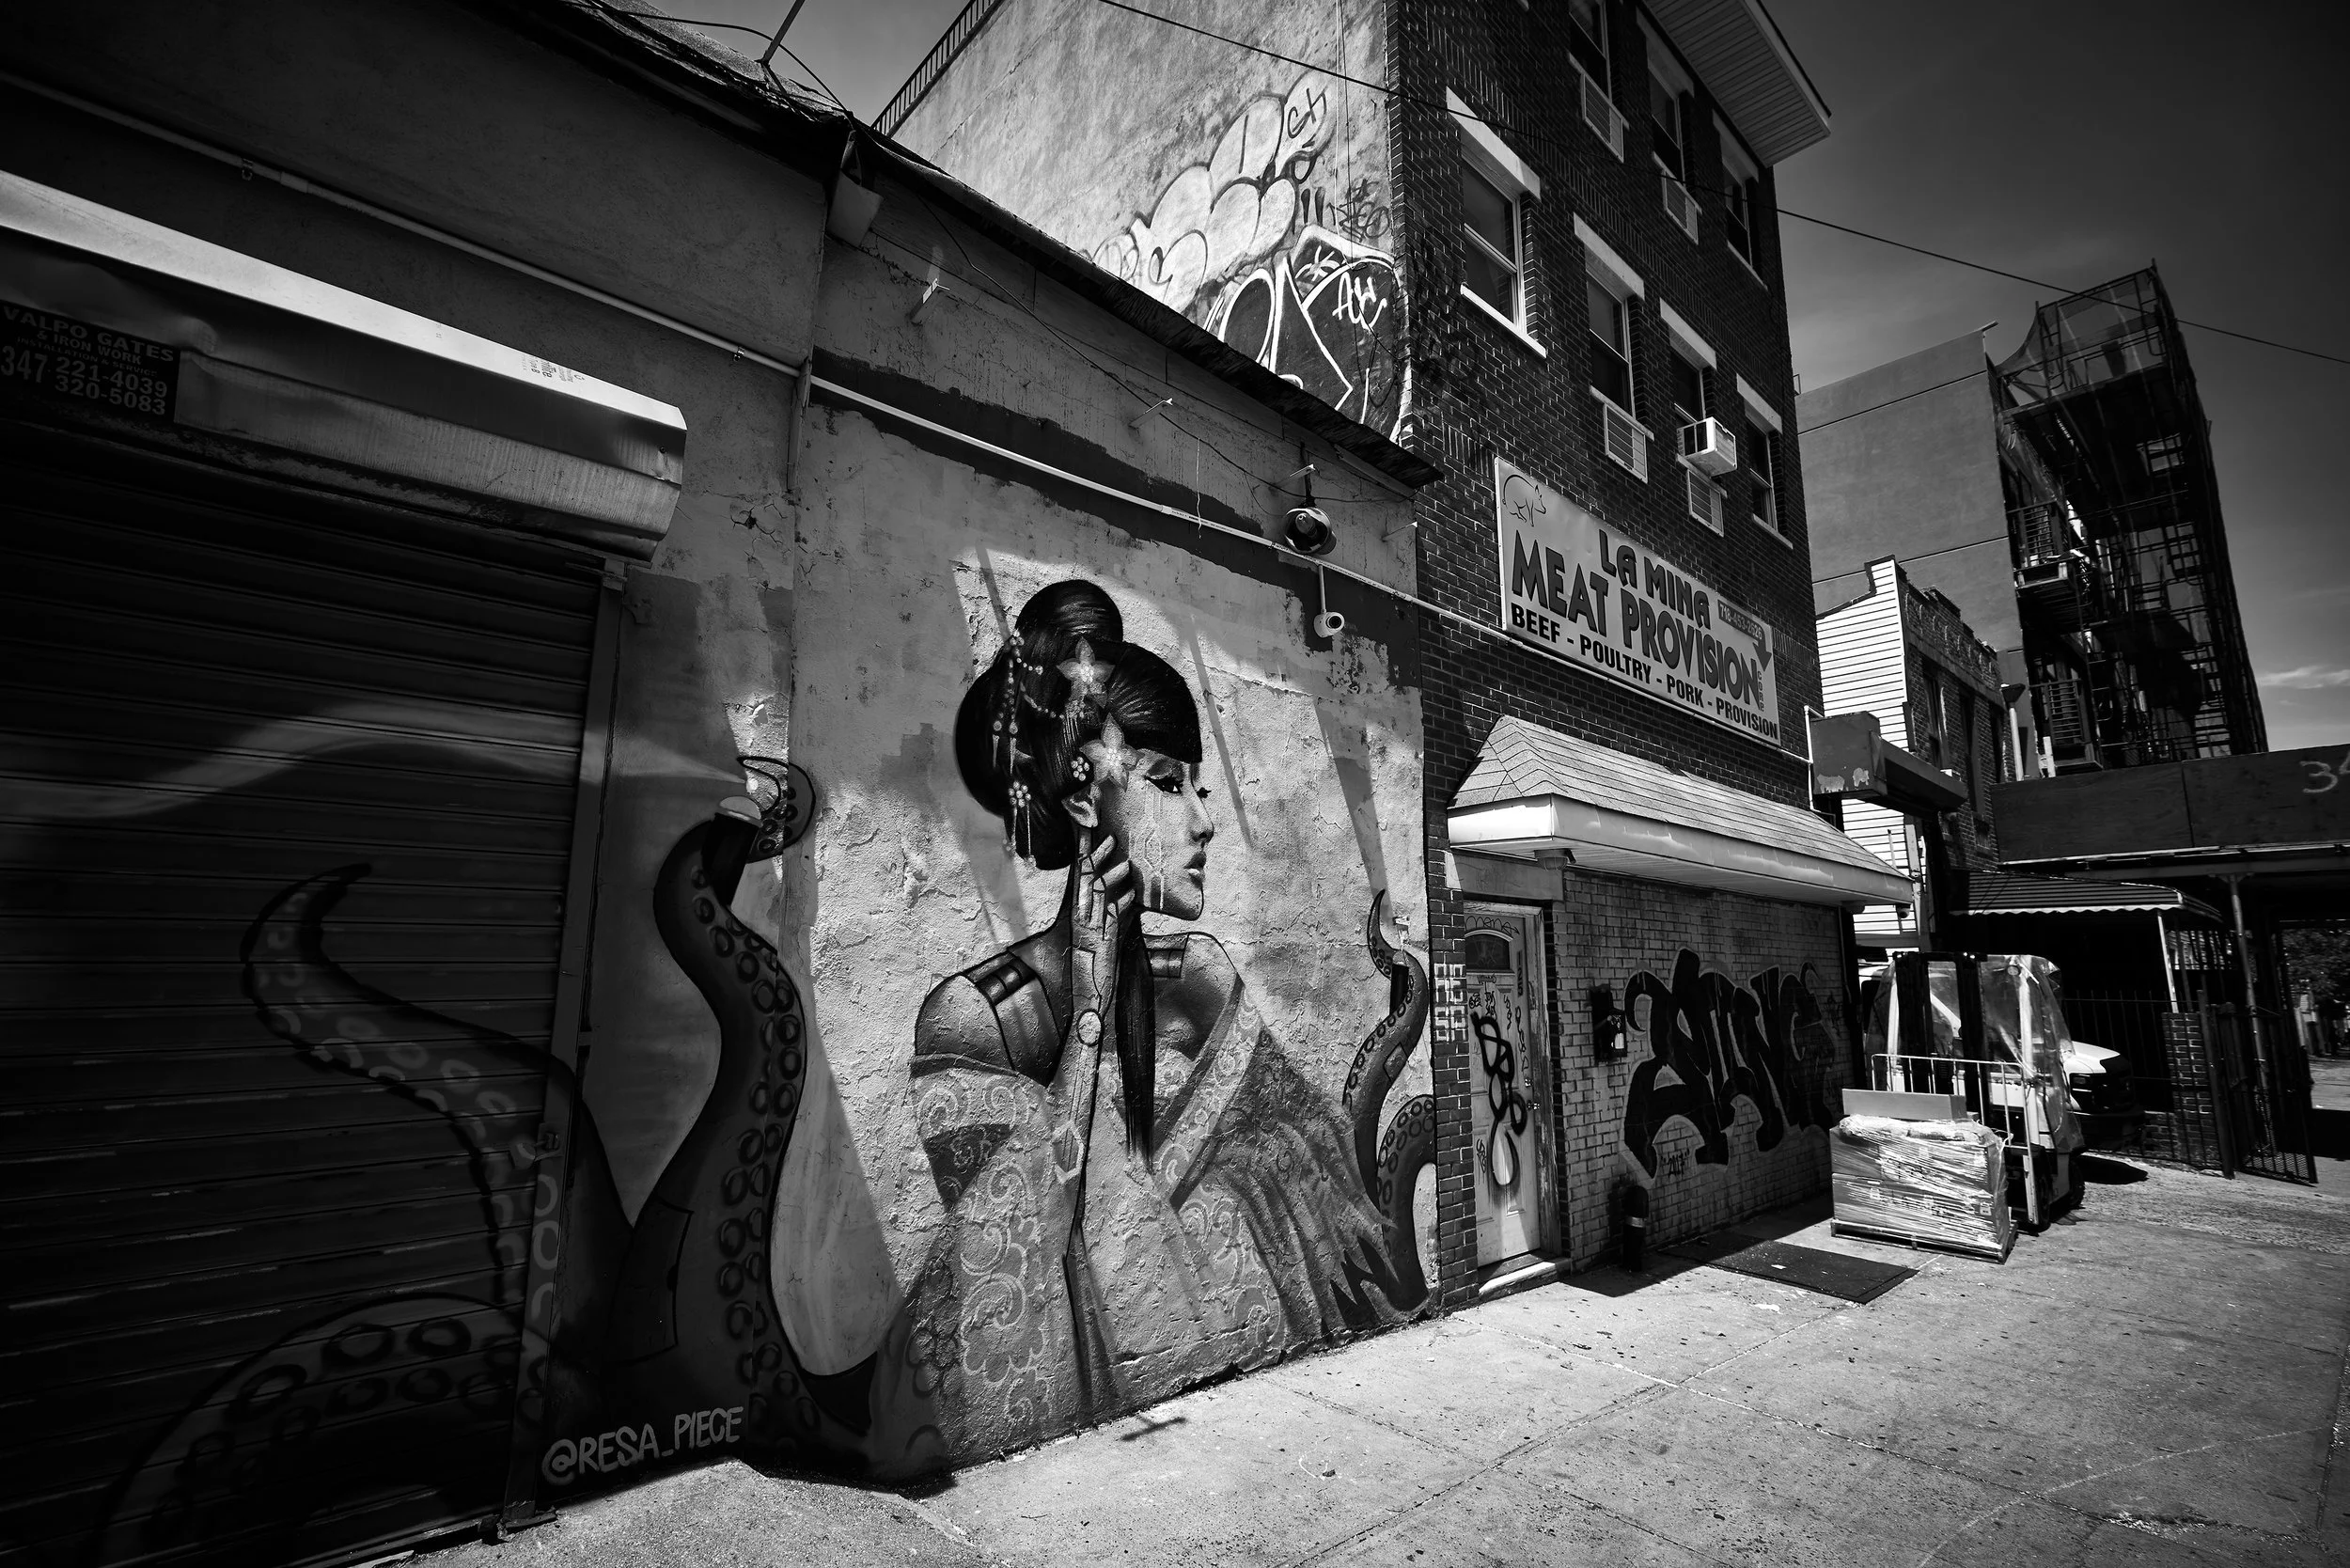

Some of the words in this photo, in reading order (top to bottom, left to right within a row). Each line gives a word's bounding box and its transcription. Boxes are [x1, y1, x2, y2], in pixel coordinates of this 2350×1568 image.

[4, 306, 88, 339] VALPO
[97, 332, 174, 362] GATES
[17, 336, 98, 363] INSTALLATION
[112, 360, 158, 378] SERVICE
[36, 330, 48, 341] &
[54, 333, 92, 353] IRON
[98, 344, 142, 366] WORK
[55, 356, 168, 399] 221-4039
[55, 374, 166, 416] 320-5083
[1599, 528, 1638, 590] LA
[1644, 556, 1711, 631] MINA
[1512, 529, 1609, 638] MEAT
[1621, 588, 1762, 711] PROVISION
[1511, 602, 1560, 644] BEEF
[1579, 634, 1652, 685] POULTRY
[1667, 673, 1704, 709] PORK
[1716, 697, 1778, 741] PROVISION
[541, 1406, 744, 1486] @RESA_PIECE
